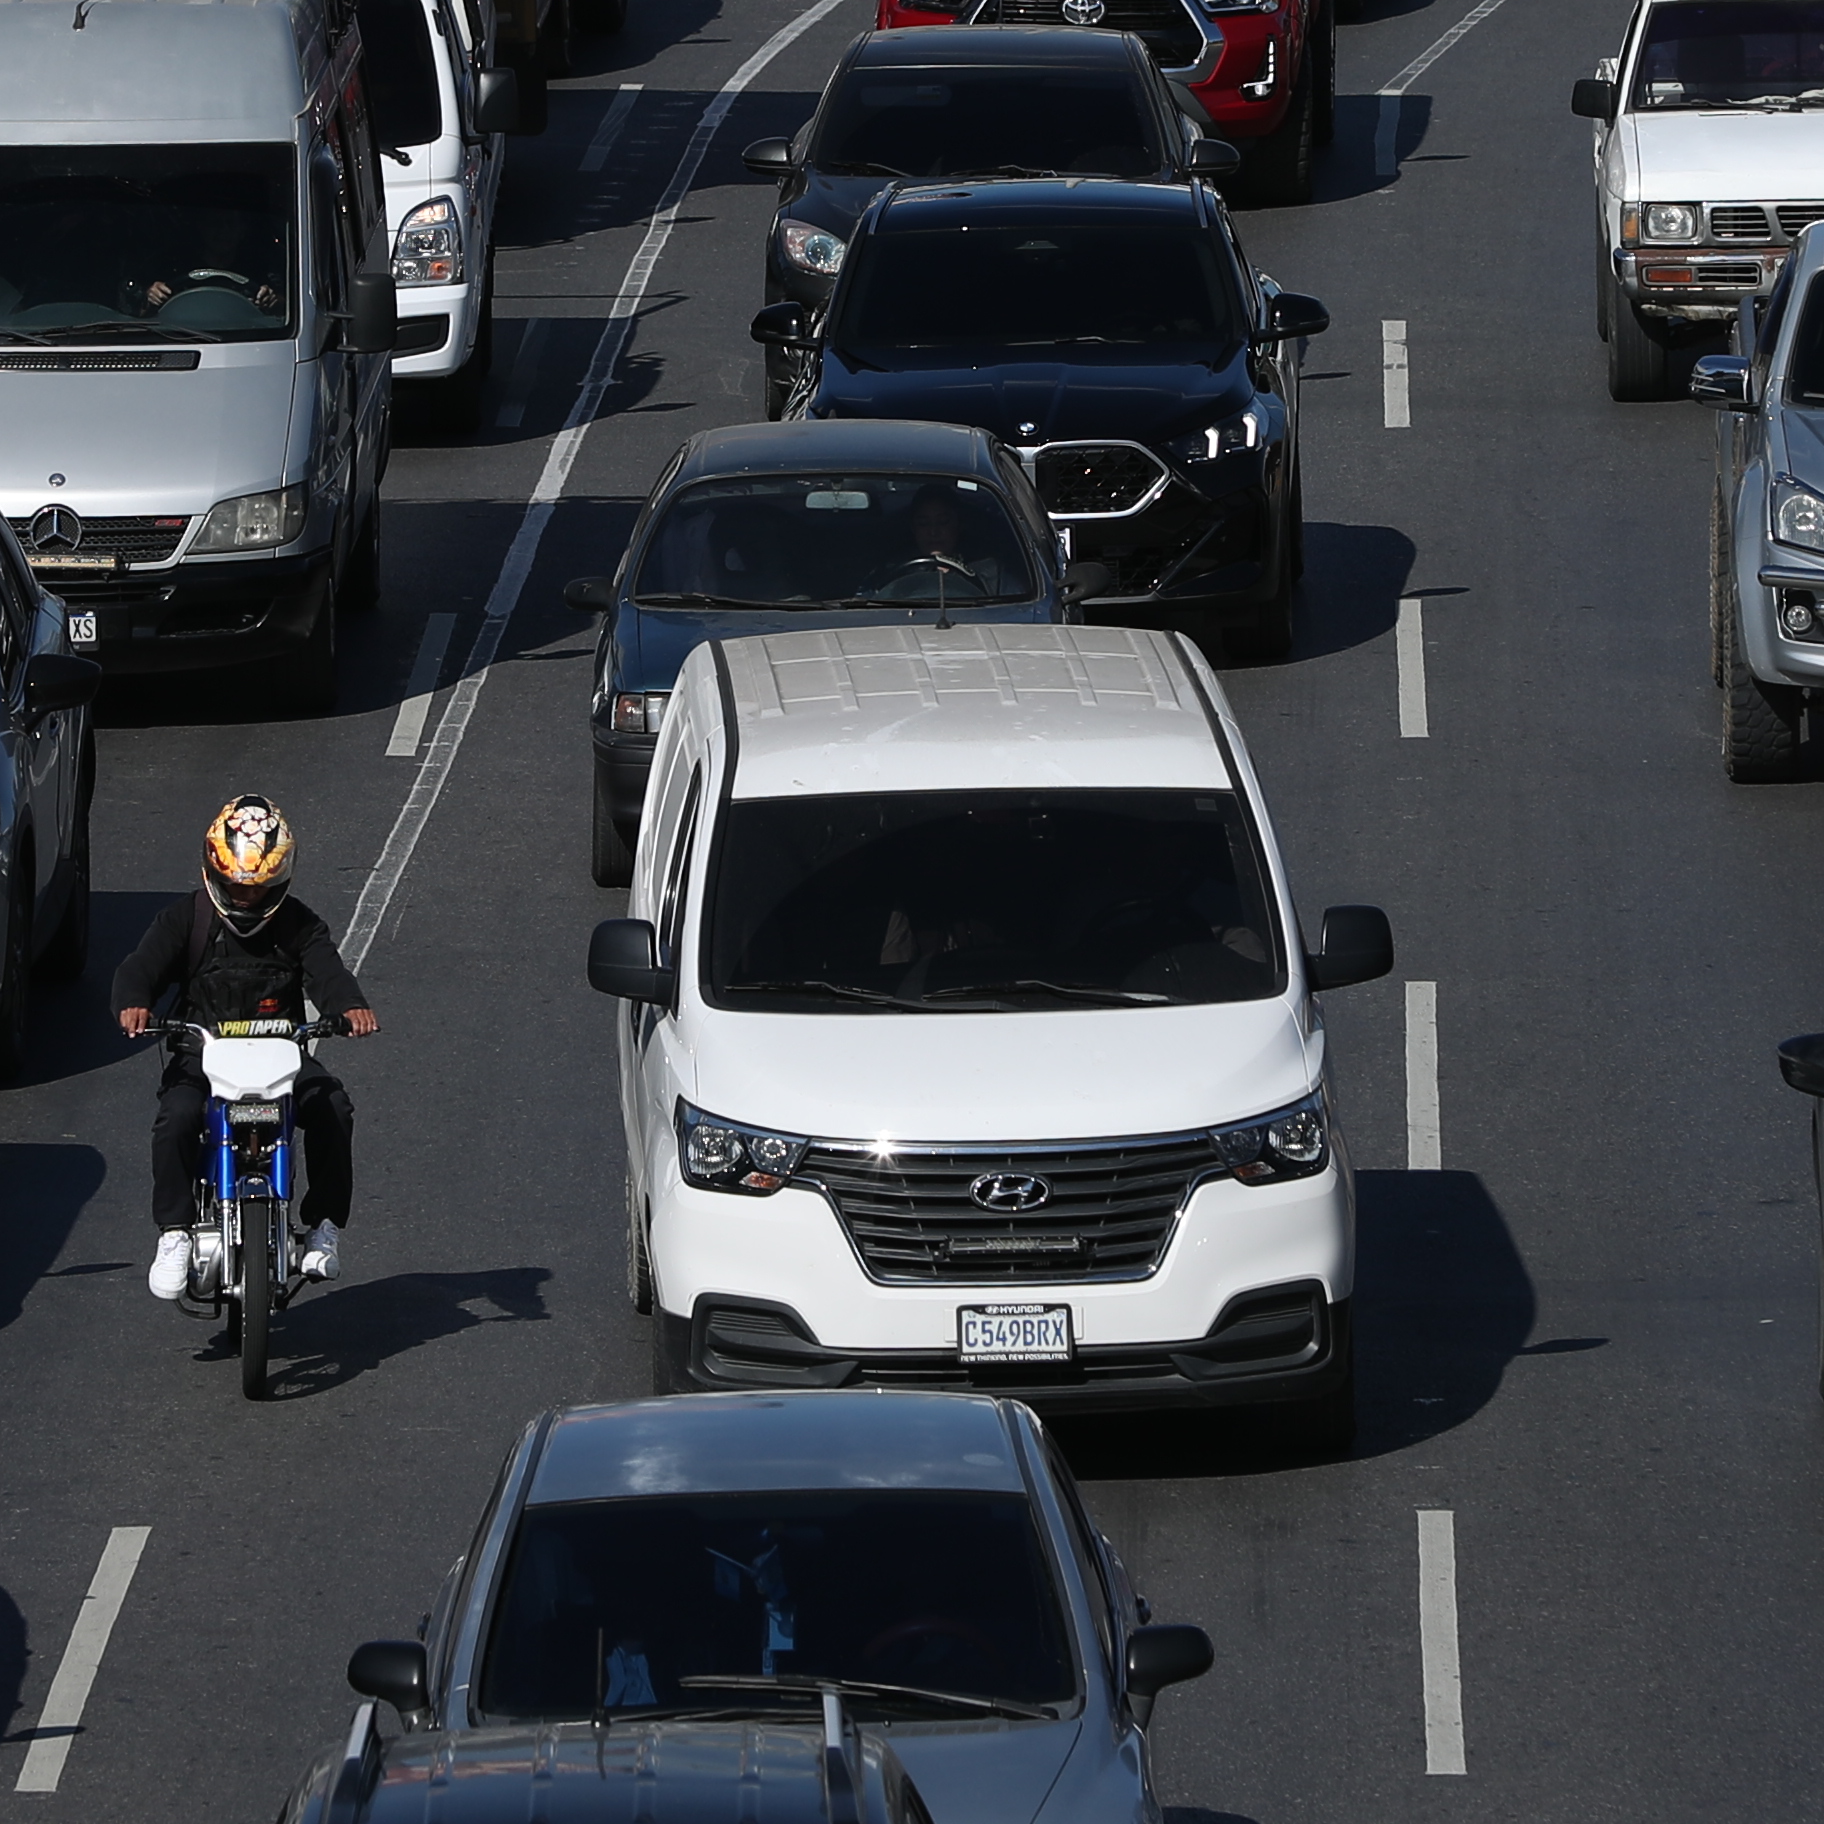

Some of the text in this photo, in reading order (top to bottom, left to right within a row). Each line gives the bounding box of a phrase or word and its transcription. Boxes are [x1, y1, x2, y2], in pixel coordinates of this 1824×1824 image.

[72, 618, 94, 639] XS
[998, 1306, 1044, 1315] HYUNDAI
[965, 1320, 1065, 1348] C549BRX
